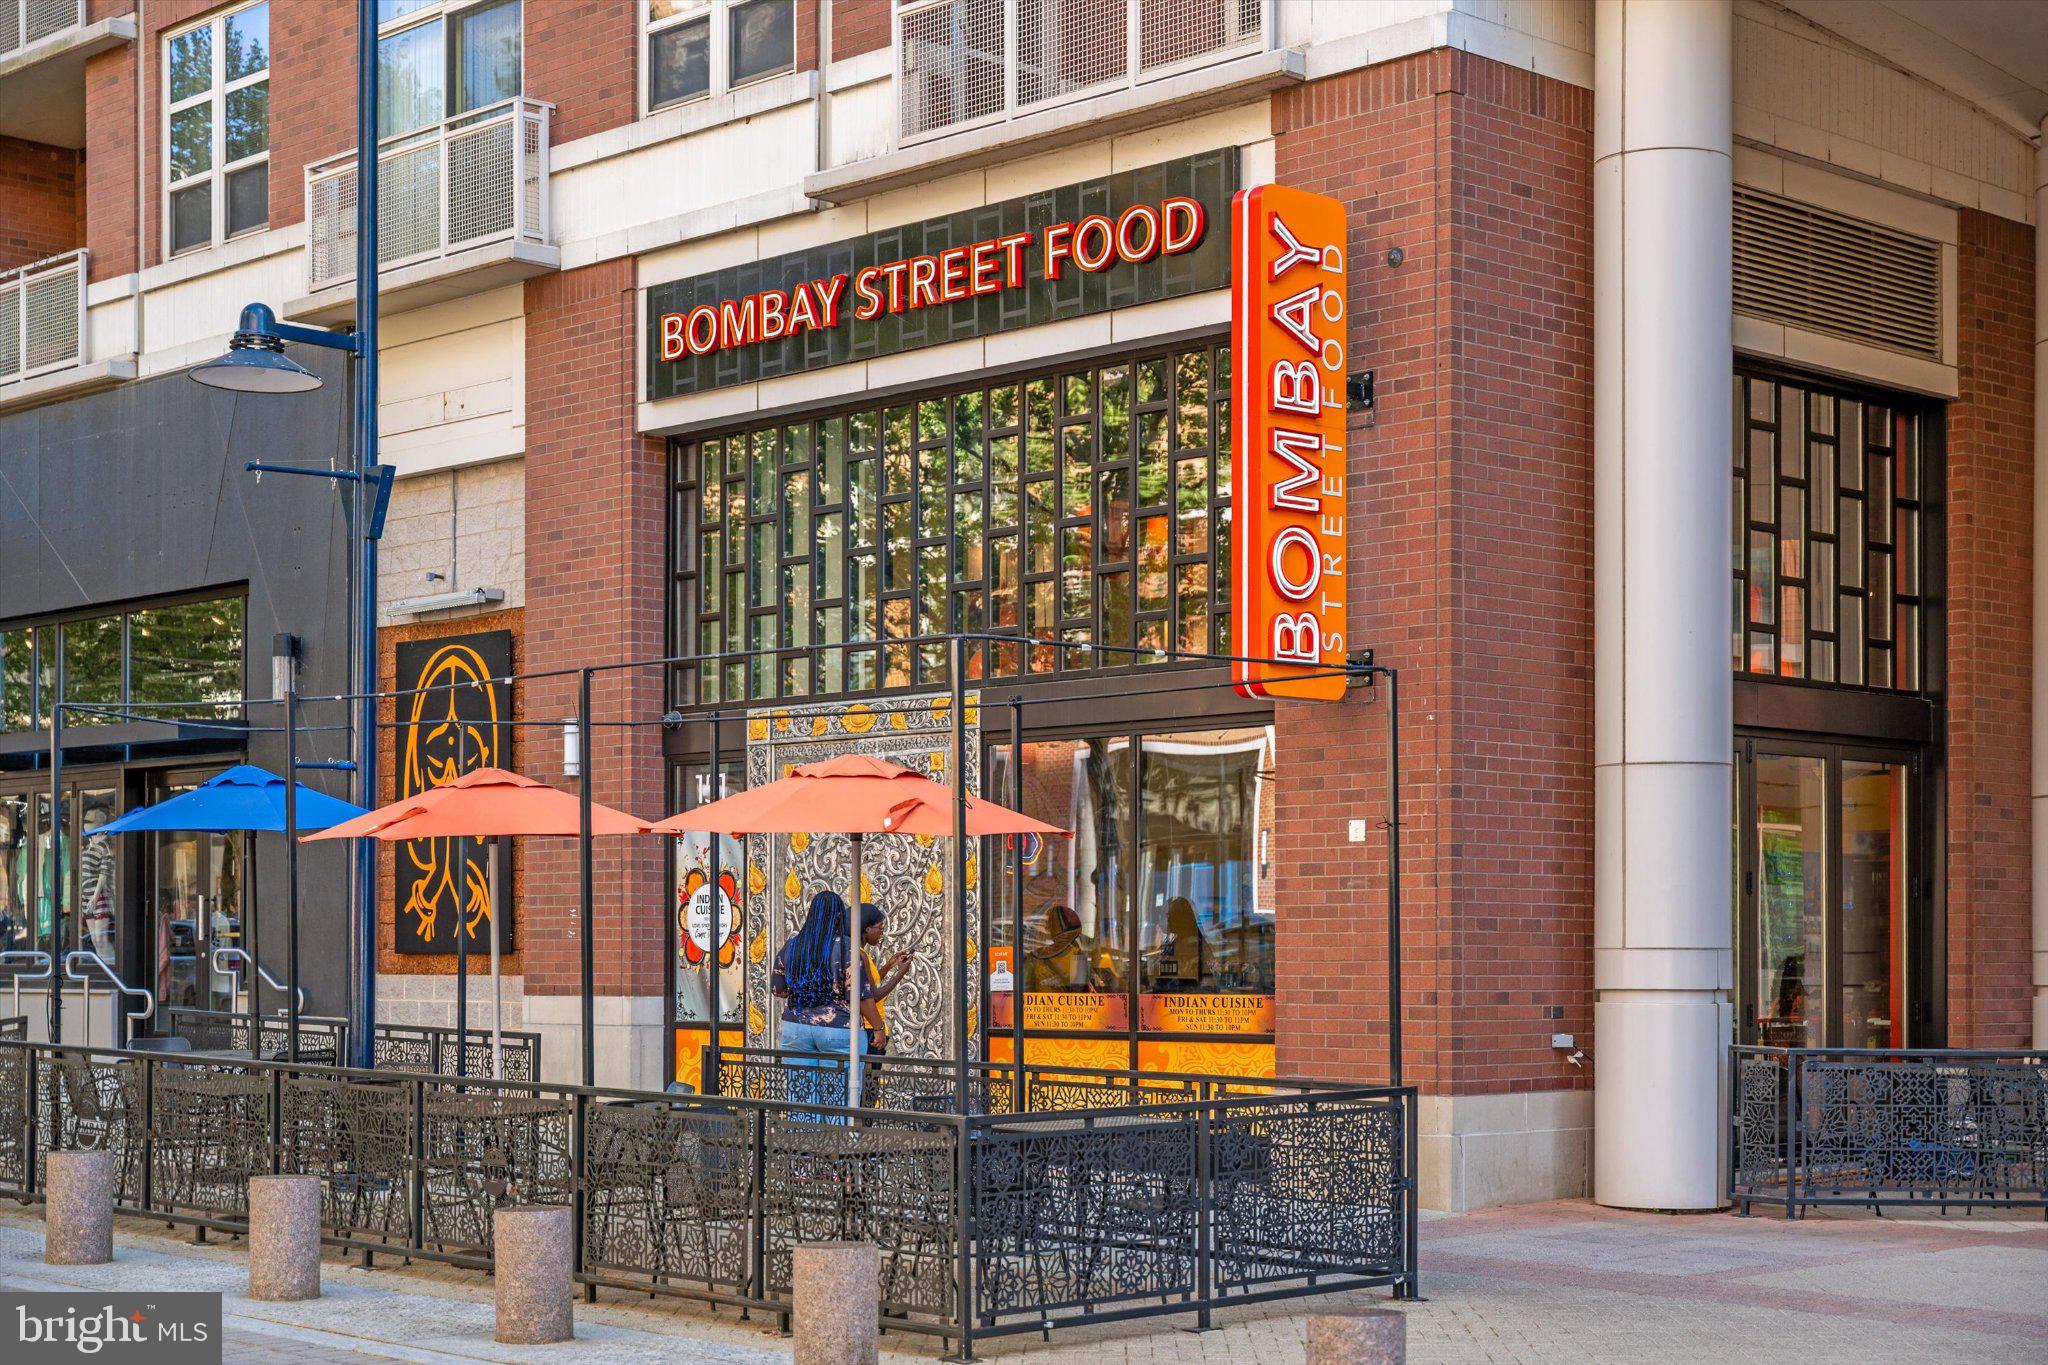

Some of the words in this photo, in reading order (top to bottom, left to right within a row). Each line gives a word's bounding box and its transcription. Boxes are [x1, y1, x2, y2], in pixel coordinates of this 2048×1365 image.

[660, 273, 846, 361] BOMBAY
[854, 231, 1032, 320] STREET
[1043, 197, 1208, 280] FOOD
[1321, 245, 1344, 409] FOOD
[1268, 211, 1323, 668] BOMBAY
[1321, 446, 1344, 653] STREET
[696, 895, 724, 903] INDN
[1058, 995, 1105, 1006] CUISINE
[1163, 996, 1207, 1008] INDIAN
[1212, 996, 1264, 1009] CUISINE
[1186, 1023, 1198, 1031] SUN
